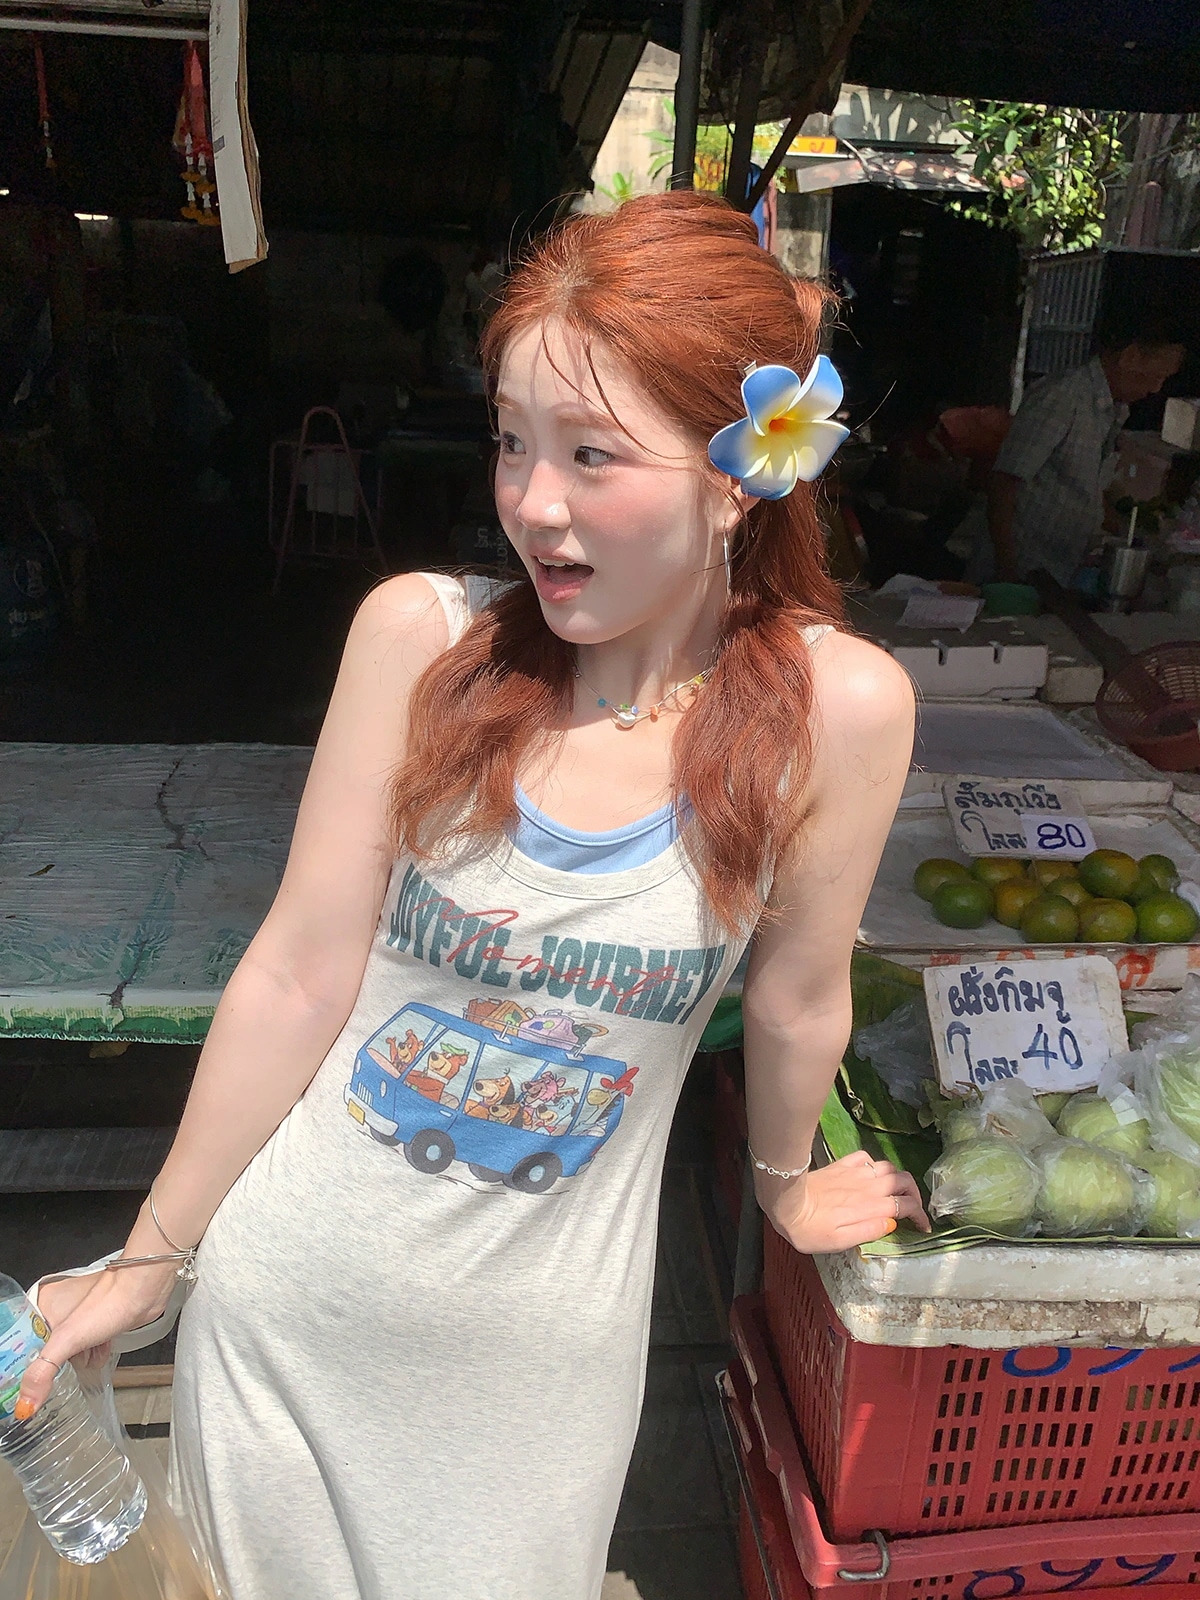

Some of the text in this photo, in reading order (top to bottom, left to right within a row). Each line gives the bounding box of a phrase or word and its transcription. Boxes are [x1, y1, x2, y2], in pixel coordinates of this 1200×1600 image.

[1036, 822, 1087, 850] 80
[519, 935, 727, 1026] JOURNEY
[1021, 1023, 1084, 1071] 40
